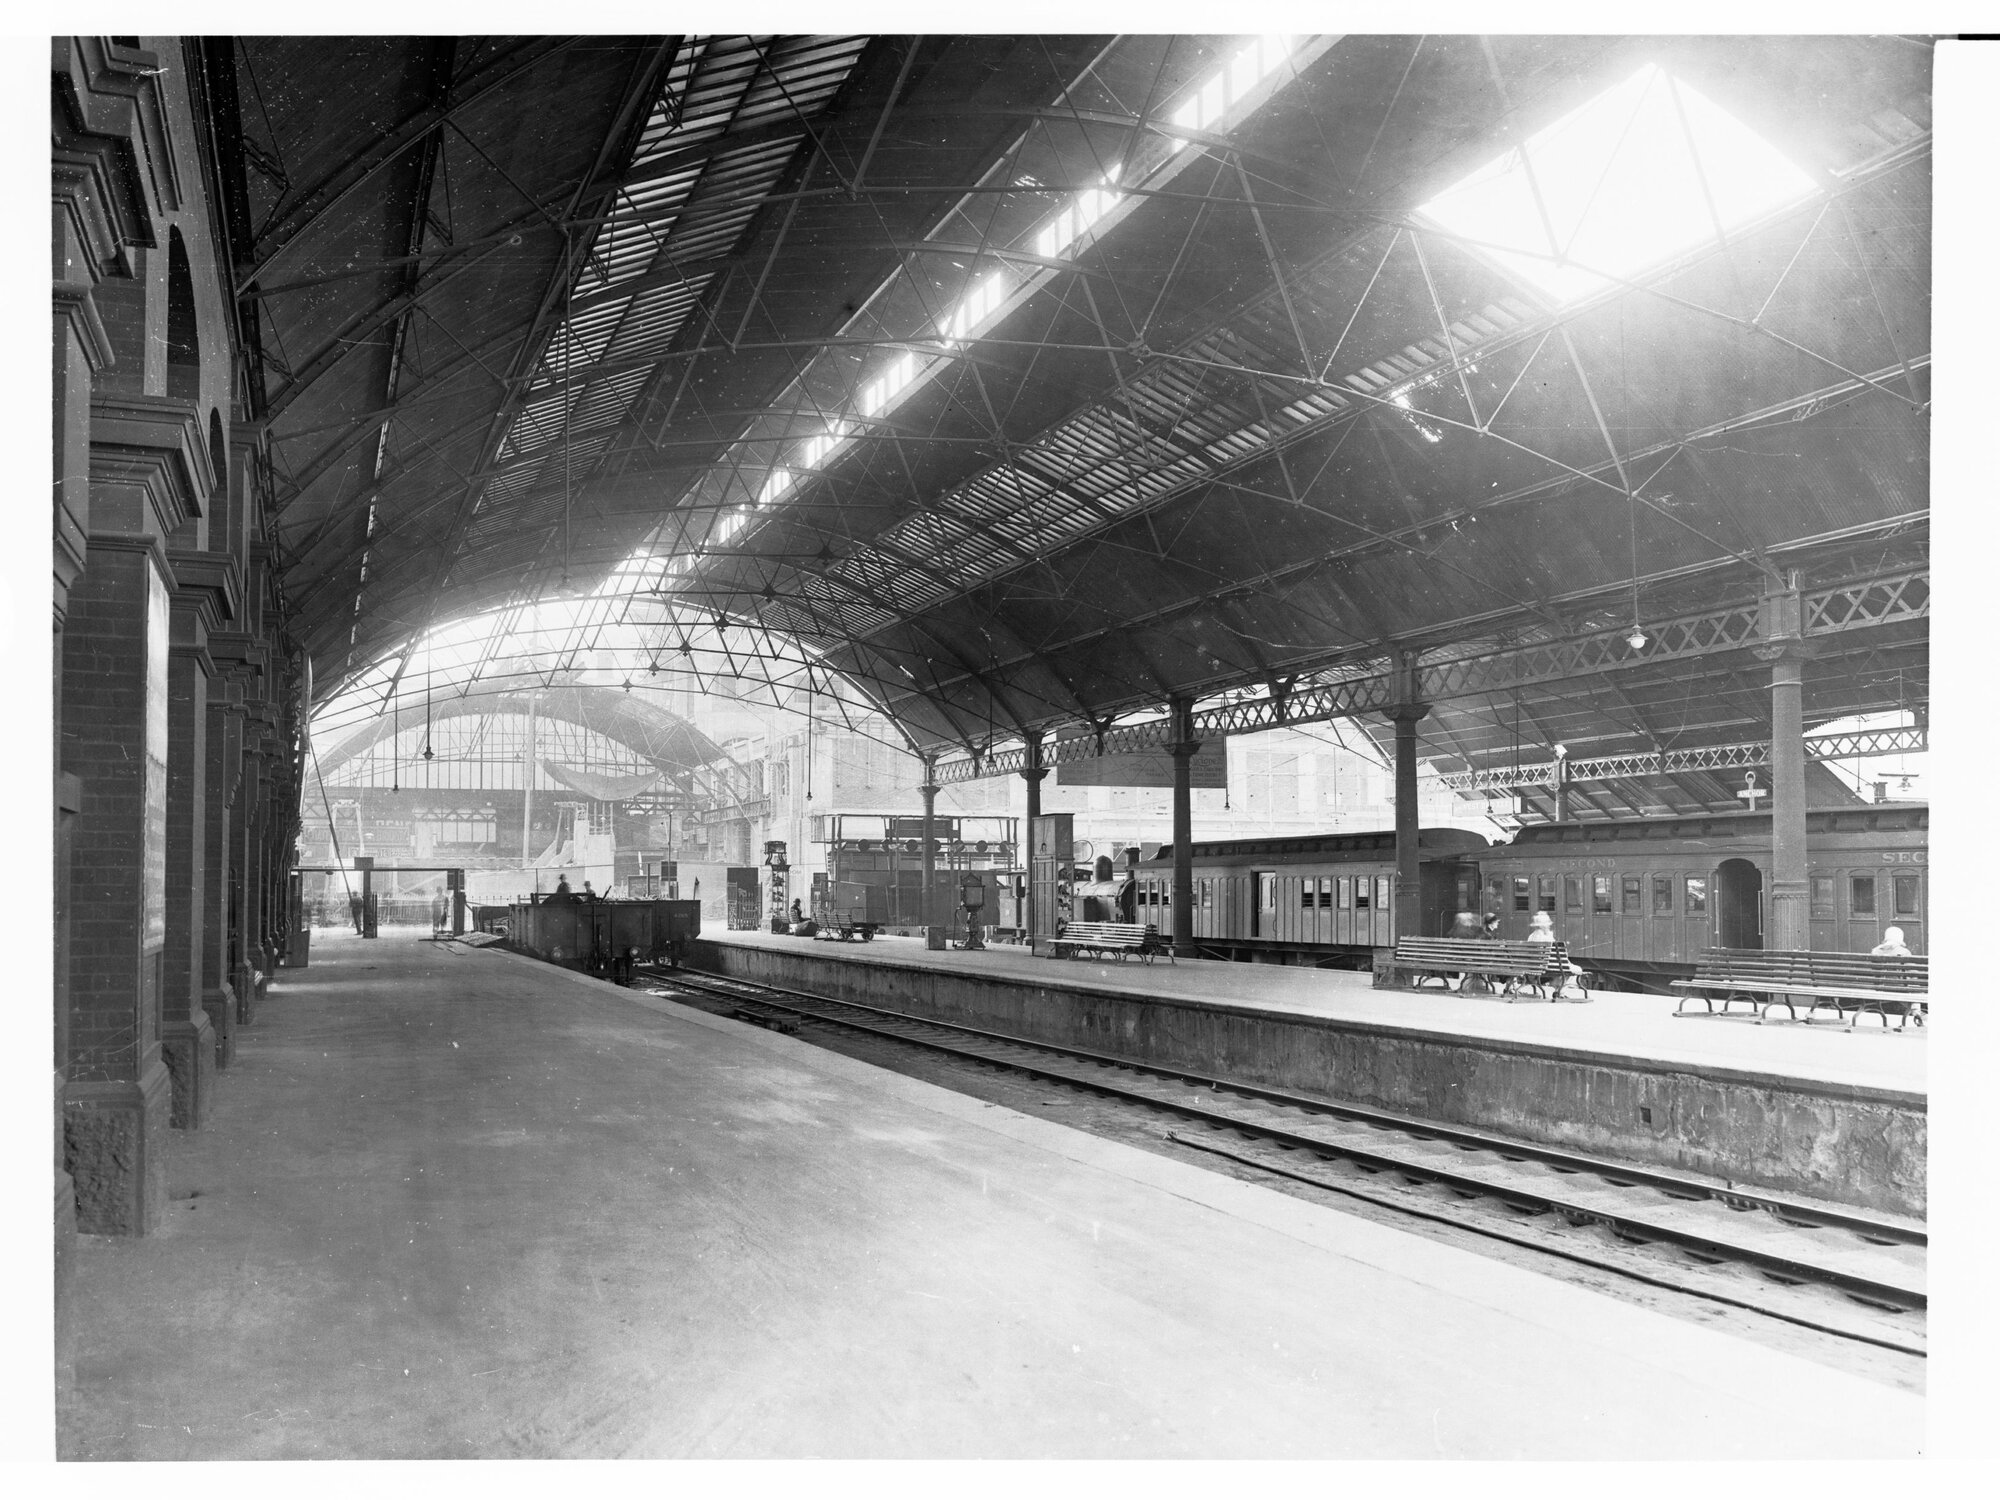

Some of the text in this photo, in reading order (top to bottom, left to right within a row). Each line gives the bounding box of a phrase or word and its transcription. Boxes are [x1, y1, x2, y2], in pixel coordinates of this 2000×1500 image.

[1738, 789, 1767, 798] ANCHOR
[1882, 851, 1925, 863] SEC
[1559, 858, 1616, 869] SECOND
